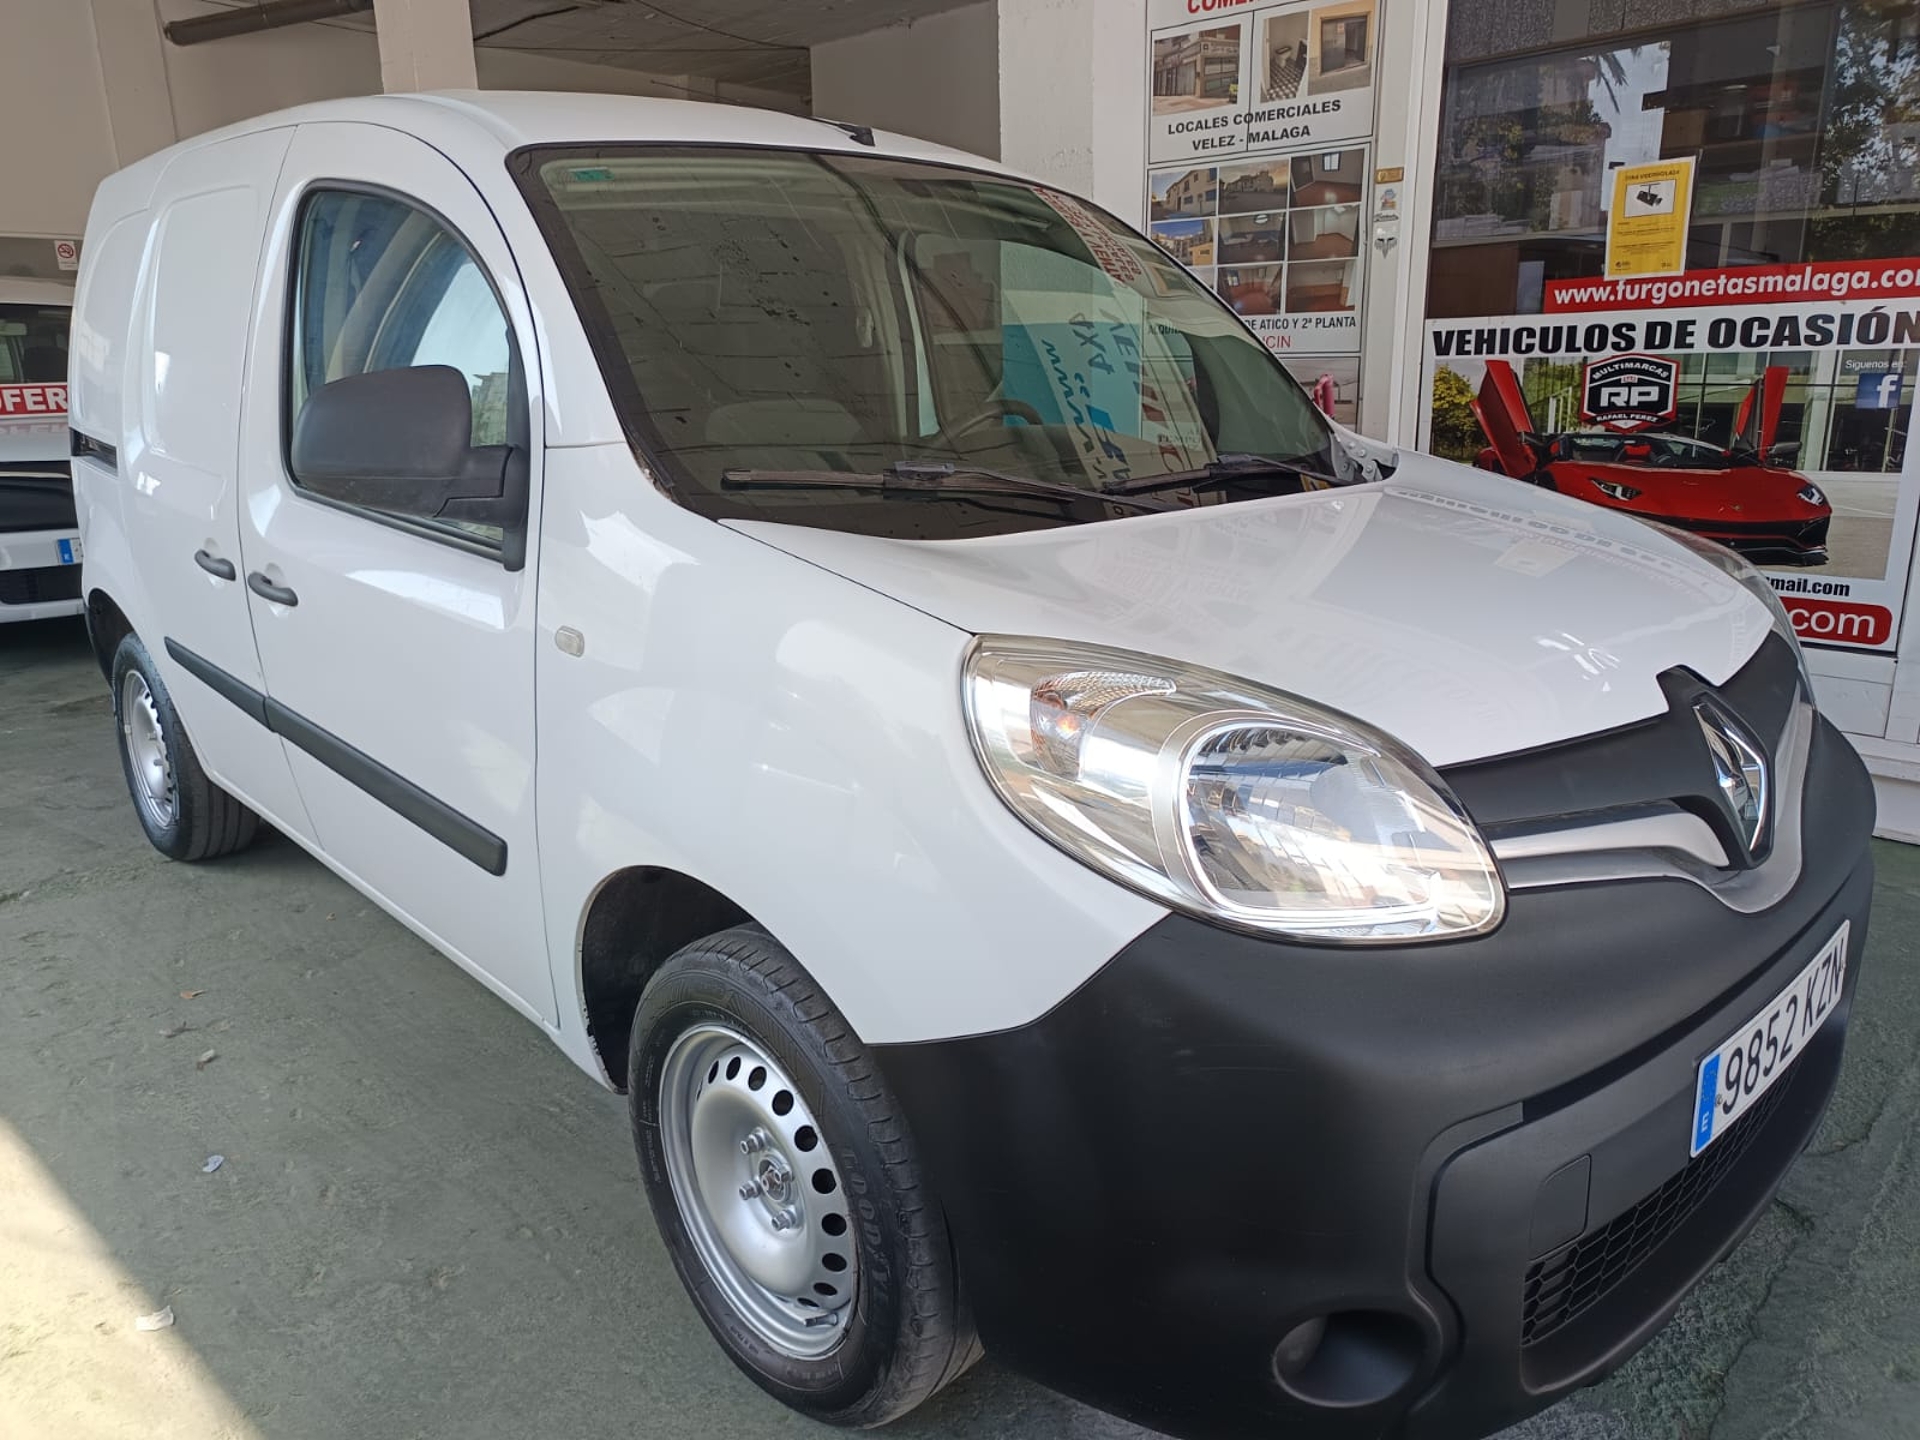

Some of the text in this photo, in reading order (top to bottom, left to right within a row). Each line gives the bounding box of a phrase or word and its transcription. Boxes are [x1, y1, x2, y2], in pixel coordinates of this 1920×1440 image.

[1186, 0, 1256, 14] COM
[1168, 99, 1342, 135] LOCALES COMERCIALES
[1192, 135, 1236, 151] VELEZ
[1248, 125, 1311, 144] MALAGA
[1554, 266, 1920, 306] www.furgonetasmalaga.co
[1260, 318, 1289, 330] ATICO
[1292, 317, 1301, 329] Y
[1314, 316, 1356, 329] PLANTA
[1432, 305, 1920, 356] VEHICULOS DE OCASIÓN
[1262, 335, 1291, 349] CIN
[1592, 361, 1670, 380] MULTIMARCAS
[0, 388, 68, 412] FER
[1600, 385, 1660, 408] RP
[1595, 413, 1628, 422] RAFAEL
[1765, 576, 1850, 597] mail.com
[1722, 937, 1844, 1116] 9852 KZN
[1700, 1110, 1710, 1133] E
